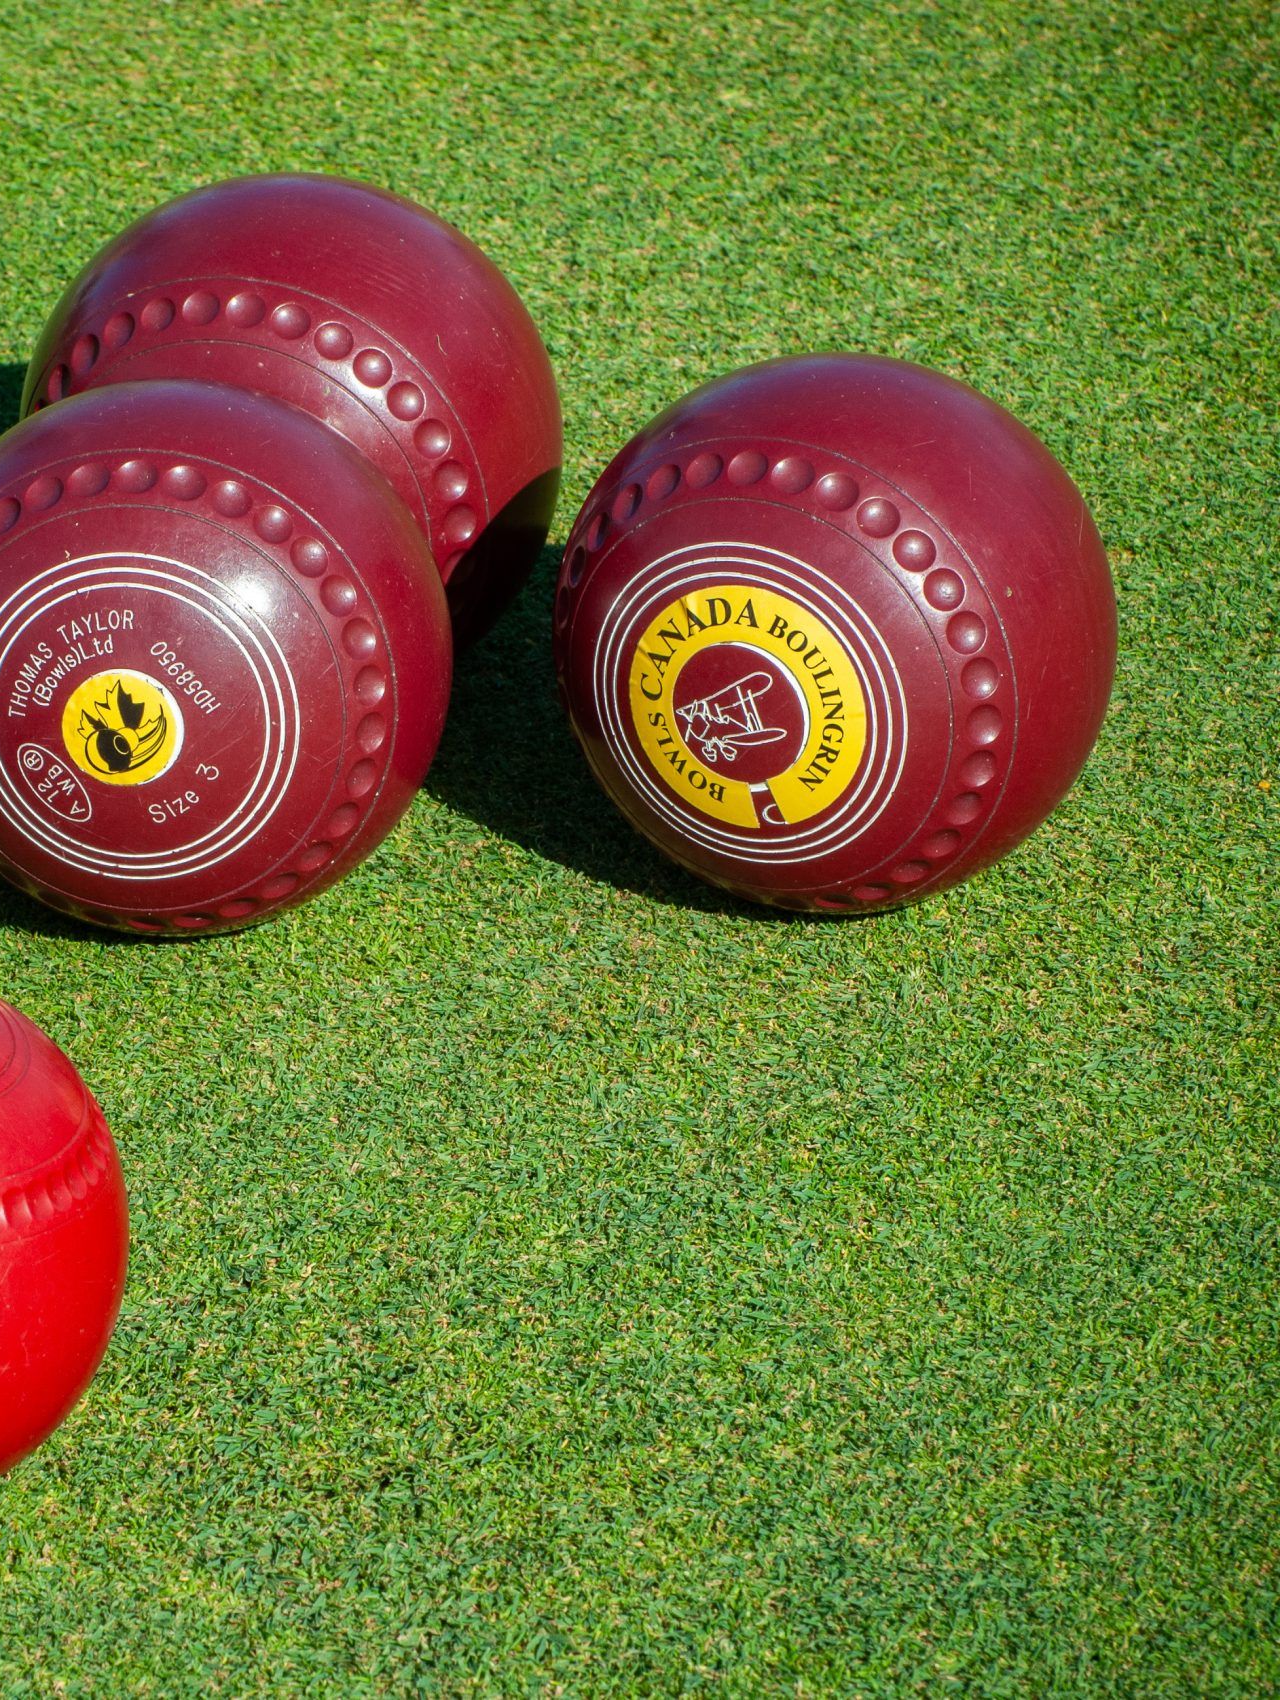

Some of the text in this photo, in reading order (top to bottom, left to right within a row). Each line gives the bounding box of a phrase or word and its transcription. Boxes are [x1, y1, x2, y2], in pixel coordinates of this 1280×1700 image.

[8, 609, 135, 719] THOMAS TAYLOR
[150, 641, 221, 715] HD58950
[639, 597, 846, 804] BOWLS CANADA BOULINGRIN
[48, 764, 76, 796] WB
[70, 800, 86, 815] A
[148, 762, 220, 824] Size 3
